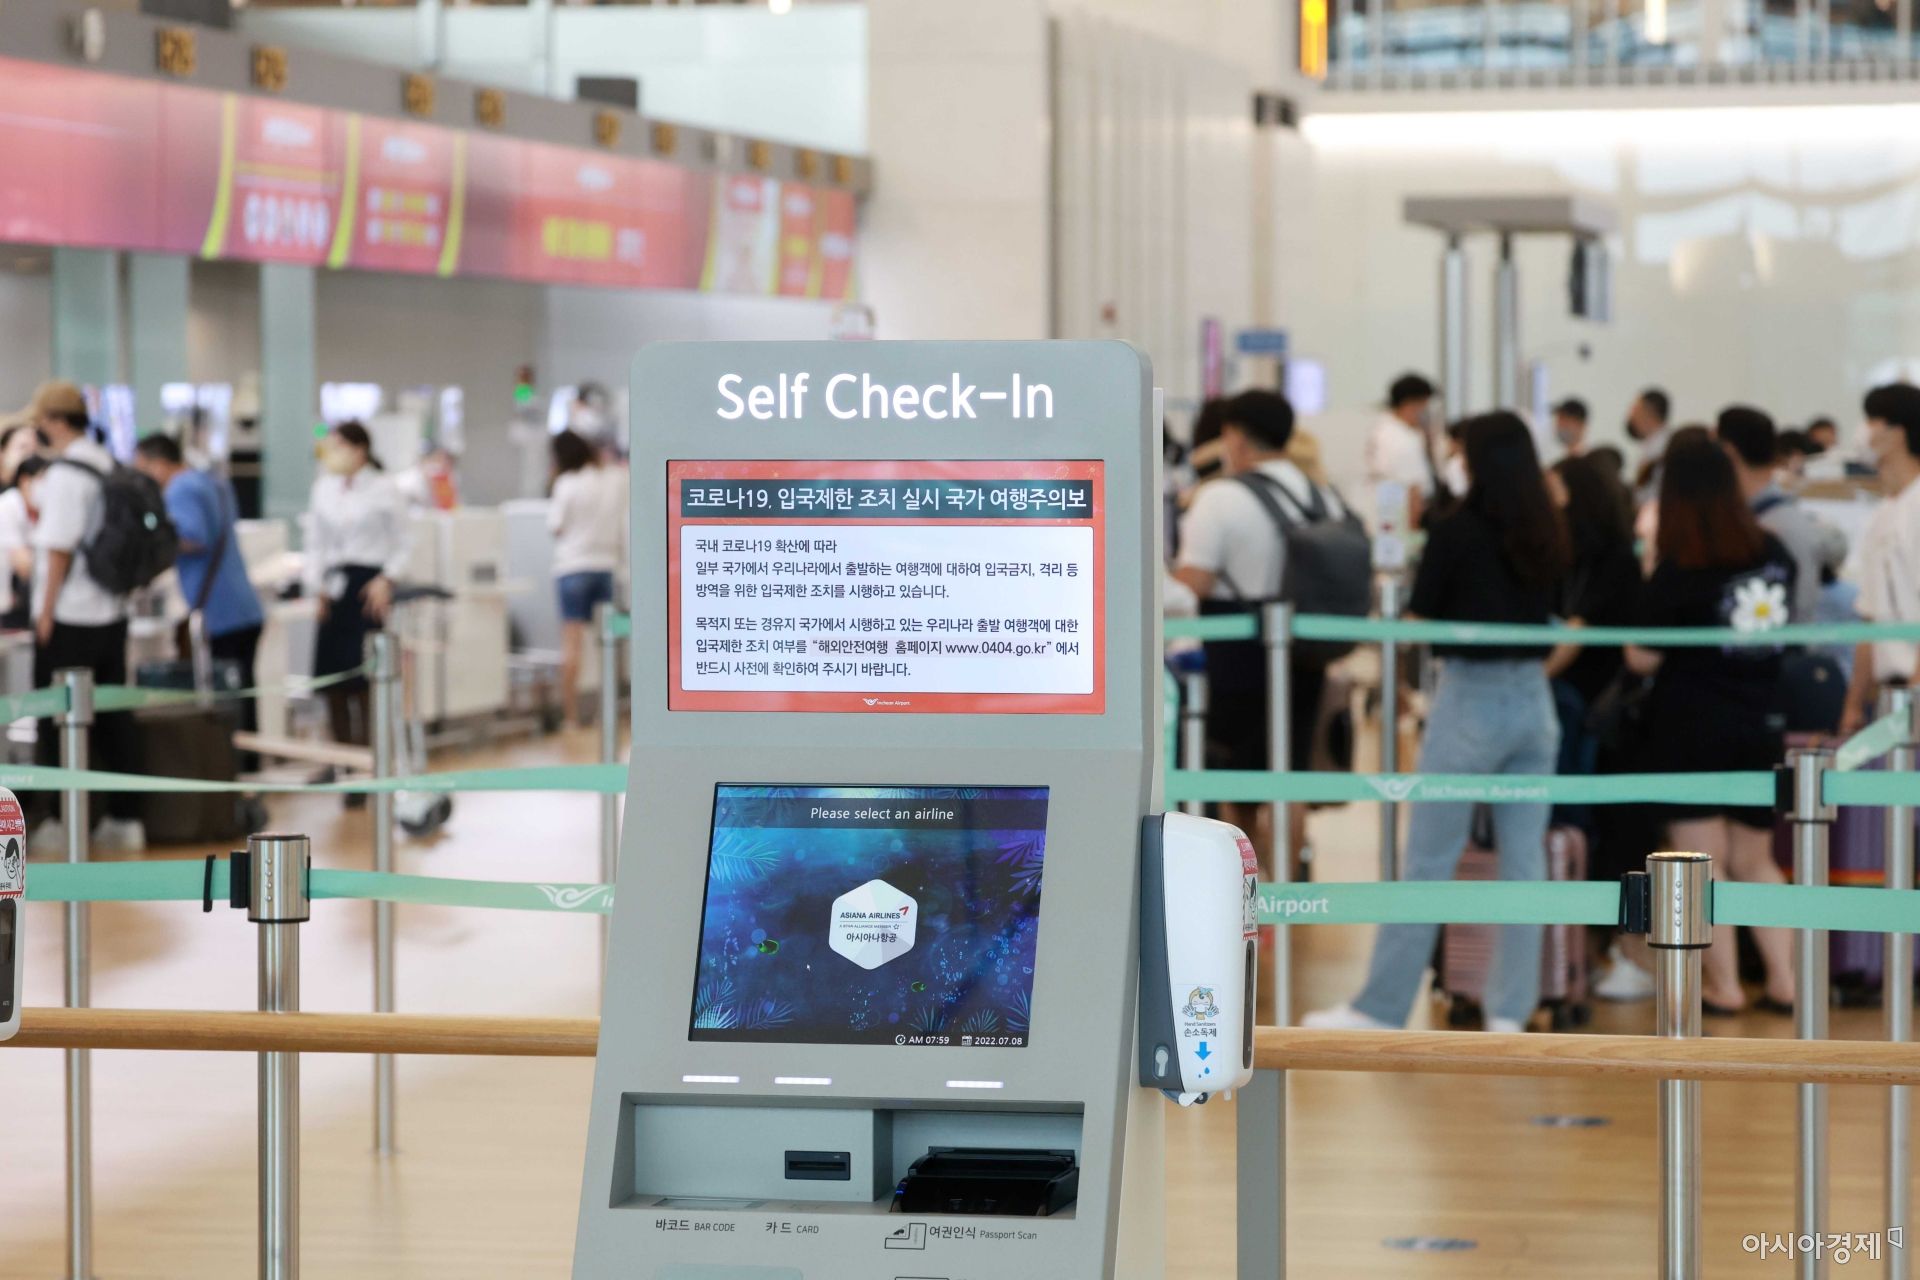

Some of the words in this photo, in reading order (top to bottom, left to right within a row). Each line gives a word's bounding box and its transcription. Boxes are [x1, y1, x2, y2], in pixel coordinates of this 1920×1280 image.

[716, 372, 810, 420] Self
[825, 372, 1054, 420] Check-In
[778, 488, 853, 510] 입국제한
[858, 488, 896, 510] 조치
[902, 488, 940, 510] 실시
[946, 488, 985, 510] 국가
[990, 488, 1087, 510] 여행주의보
[695, 539, 719, 553] 국내
[722, 539, 772, 553] 코로나19
[775, 539, 810, 553] 확산에
[814, 539, 838, 553] 따라
[696, 561, 719, 575] 일부
[722, 561, 768, 575] 국가에서
[772, 561, 842, 575] 우리나라에서
[845, 561, 892, 575] 출발하는
[896, 562, 942, 577] 여행객에
[946, 562, 981, 577] 대하여
[985, 562, 1035, 577] 입국금지,
[1039, 563, 1063, 577] 격리
[1066, 563, 1079, 577] 등
[696, 583, 730, 598] 방역을
[734, 583, 758, 598] 위한
[761, 583, 807, 598] 입국제한
[810, 583, 845, 598] 조치를
[849, 583, 896, 598] 시행하고
[899, 584, 950, 599] 있습니다.
[695, 617, 730, 632] 목적지
[734, 617, 757, 632] 또는
[761, 617, 795, 632] 경유지
[799, 617, 845, 632] 국가에서
[849, 617, 896, 632] 시행하고
[899, 617, 923, 632] 있는
[926, 618, 973, 633] 우리나라
[976, 618, 1000, 633] 출발
[1004, 618, 1051, 633] 여행객에
[1055, 618, 1079, 633] 대한
[696, 639, 742, 653] 입국제한
[745, 639, 769, 653] 조치
[772, 639, 807, 653] 여부를
[895, 640, 942, 655] 홈페이지
[1055, 641, 1079, 656] 에서
[696, 661, 730, 676] 반드시
[734, 661, 769, 676] 사전에
[772, 661, 819, 676] 확인하여
[822, 661, 857, 676] 주시기
[861, 662, 911, 677] 바랍니다.
[811, 807, 850, 819] Please
[854, 807, 891, 820] select
[894, 809, 910, 820] an
[914, 808, 954, 820] airline
[1257, 895, 1328, 917] Airport
[846, 932, 897, 943] 아시아나항공
[909, 1036, 923, 1044] AM
[926, 1036, 950, 1044] 07:59
[1184, 1028, 1217, 1038] 손소독제
[974, 1037, 1022, 1045] 2022.07.08
[655, 1218, 690, 1232] 바코드
[694, 1222, 711, 1231] BAR
[713, 1223, 735, 1232] CODE
[796, 1225, 819, 1234] CARD
[930, 1226, 976, 1239] 여권인식
[980, 1230, 1015, 1241] Passport
[1018, 1231, 1037, 1240] Scan
